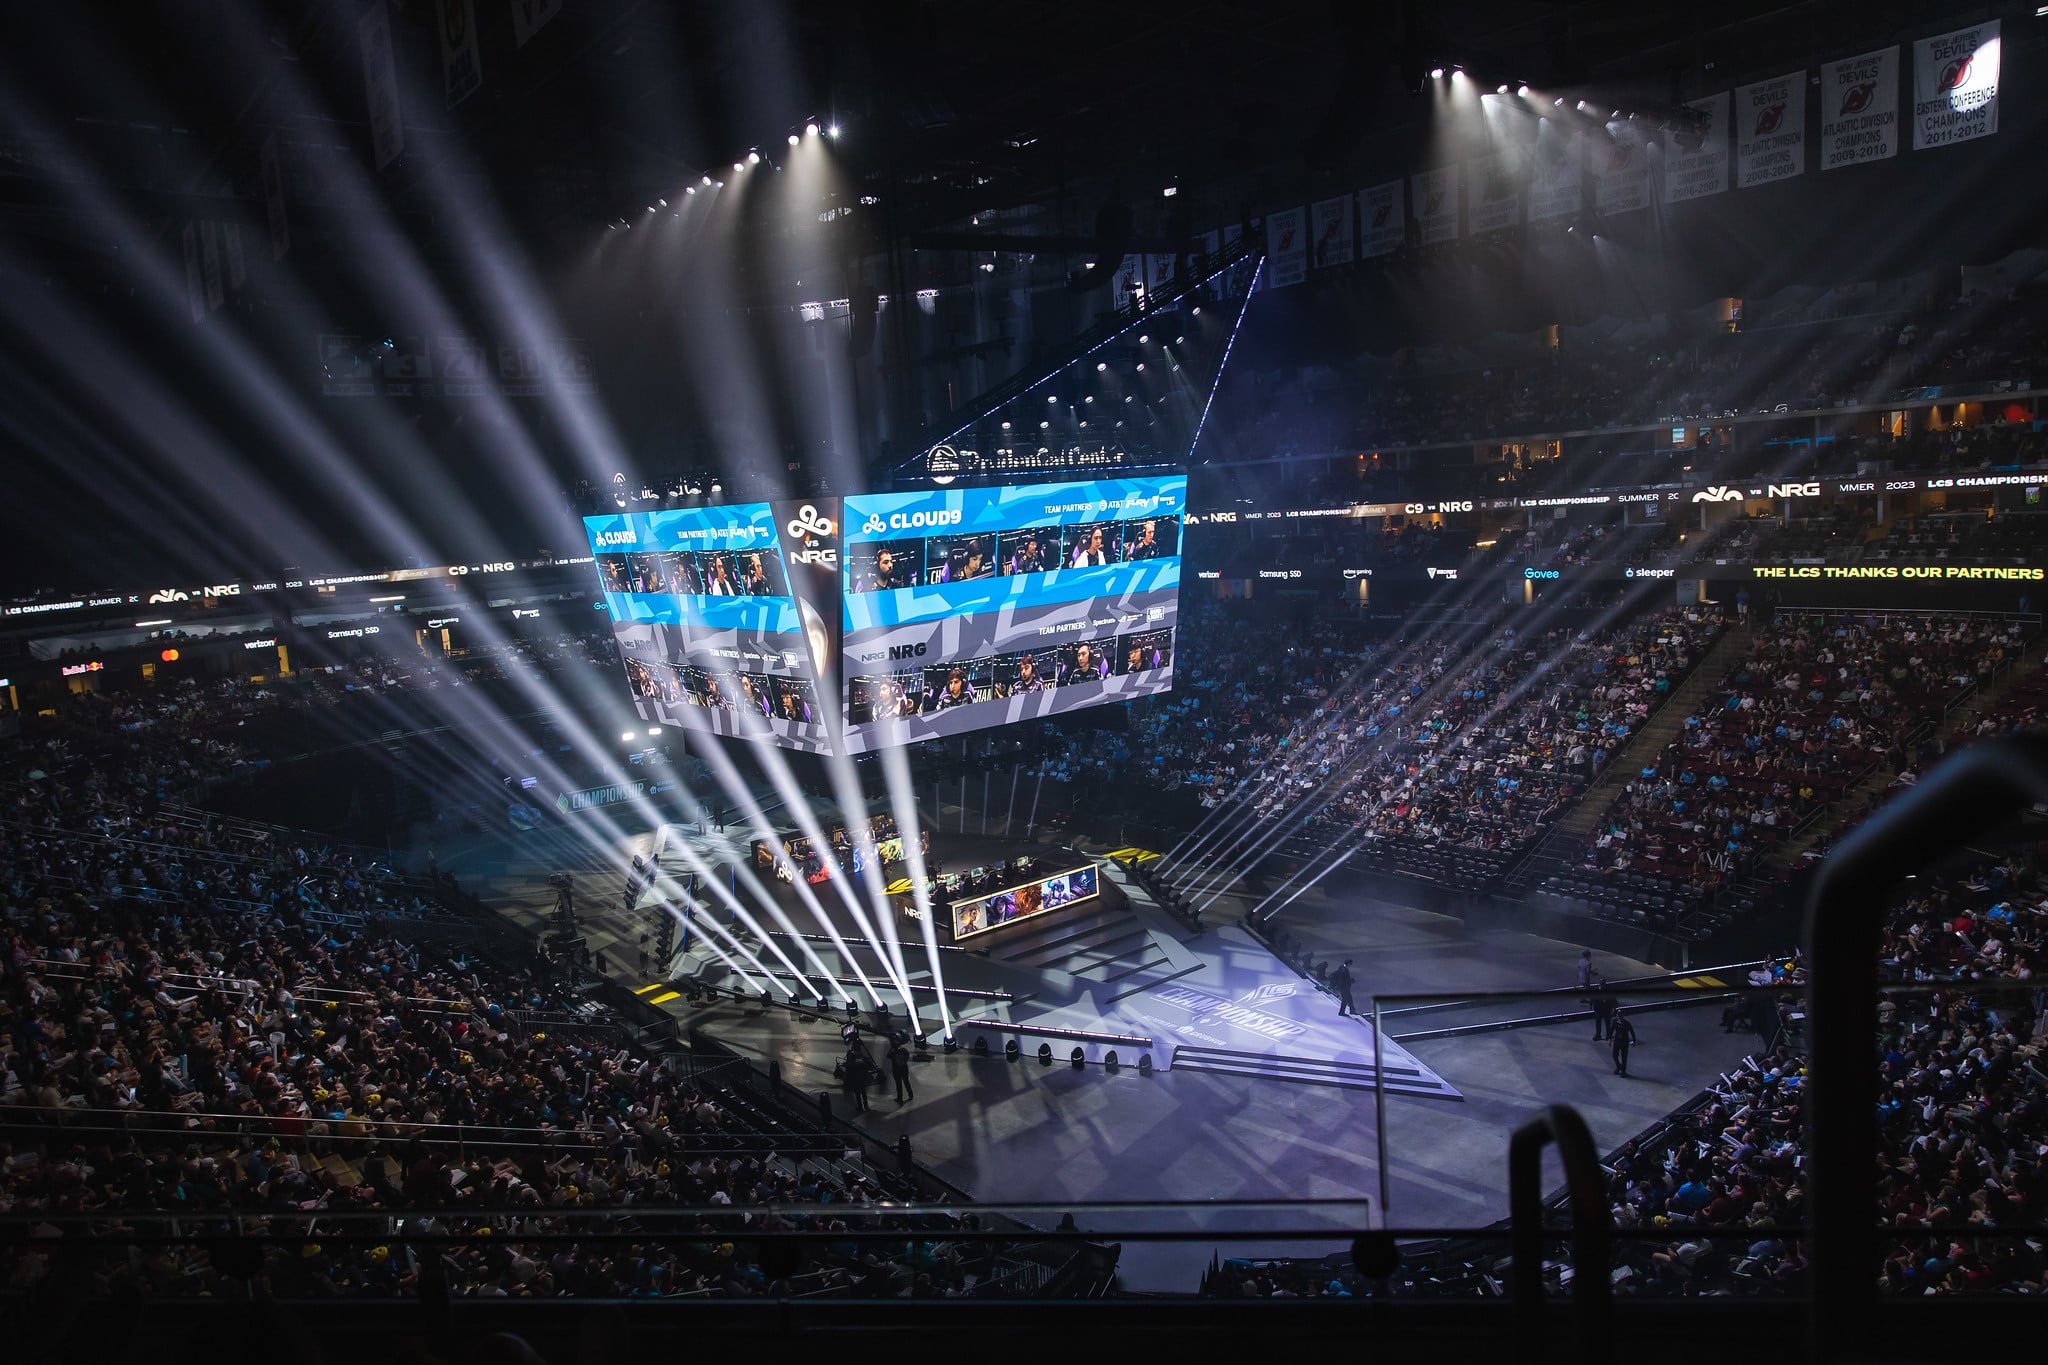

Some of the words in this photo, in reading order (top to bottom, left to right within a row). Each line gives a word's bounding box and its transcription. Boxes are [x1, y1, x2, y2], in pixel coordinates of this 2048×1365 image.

[1930, 38, 1948, 50] NEW
[1950, 29, 1981, 46] JERSEY
[1934, 40, 1978, 60] DEVILS
[1839, 66, 1879, 84] DEVILS
[1753, 88, 1788, 106] DEVILS
[1917, 98, 1948, 115] EASTERN
[1949, 86, 1995, 109] CONFERENCE
[1824, 118, 1859, 137] ATLANTIC
[1860, 112, 1895, 130] DIVISION
[1925, 105, 1986, 131] CHAMPIONS
[1835, 130, 1881, 150] CHAMPIONS
[1926, 122, 1986, 145] 2011-2012
[1751, 150, 1790, 170] CHAMPIONS
[1830, 144, 1887, 164] 2009-2010
[1768, 483, 1821, 498] NRG
[1886, 481, 1916, 490] 2023
[1927, 479, 1954, 488] LCS
[1107, 500, 1124, 509] AT&T
[1405, 503, 1424, 514] C9
[1439, 501, 1473, 513] NRG
[1520, 499, 1537, 507] LCS
[1538, 496, 1610, 506] CHAMPIONSHIP
[1618, 493, 1659, 502] SUMMER
[1044, 505, 1061, 514] TEAM
[1062, 502, 1092, 512] PARTNERS
[890, 509, 962, 529] CLOUD9
[1210, 512, 1237, 523] NRG
[605, 530, 637, 545] CLOUD9
[790, 549, 837, 564] NRG
[448, 565, 468, 576] C9
[483, 561, 515, 573] NRG
[1259, 570, 1288, 580] Samsung
[1290, 570, 1302, 578] SSD
[1524, 567, 1560, 579] Govee
[1636, 568, 1675, 578] sleeper
[1753, 567, 1786, 578] THE
[1789, 567, 1820, 578] LCS
[1824, 567, 1898, 578] THANKS
[1901, 567, 1942, 578] OUR
[1946, 567, 2045, 580] PARTNERS
[204, 584, 240, 598] NRG
[22, 601, 85, 614] CHAMPIONSHIP
[89, 597, 122, 607] SUMMER
[328, 628, 363, 639] Samsung
[365, 626, 380, 635] SSD
[1039, 626, 1055, 635] TEAM
[1056, 621, 1086, 633] PARTNERS
[244, 639, 275, 649] verizon
[861, 651, 885, 662] NRG
[889, 642, 927, 661] NRG
[572, 782, 644, 809] CHAMPIONSHIP
[904, 906, 925, 920] NRG
[1156, 987, 1308, 1037] CHAMPIONSHIP
